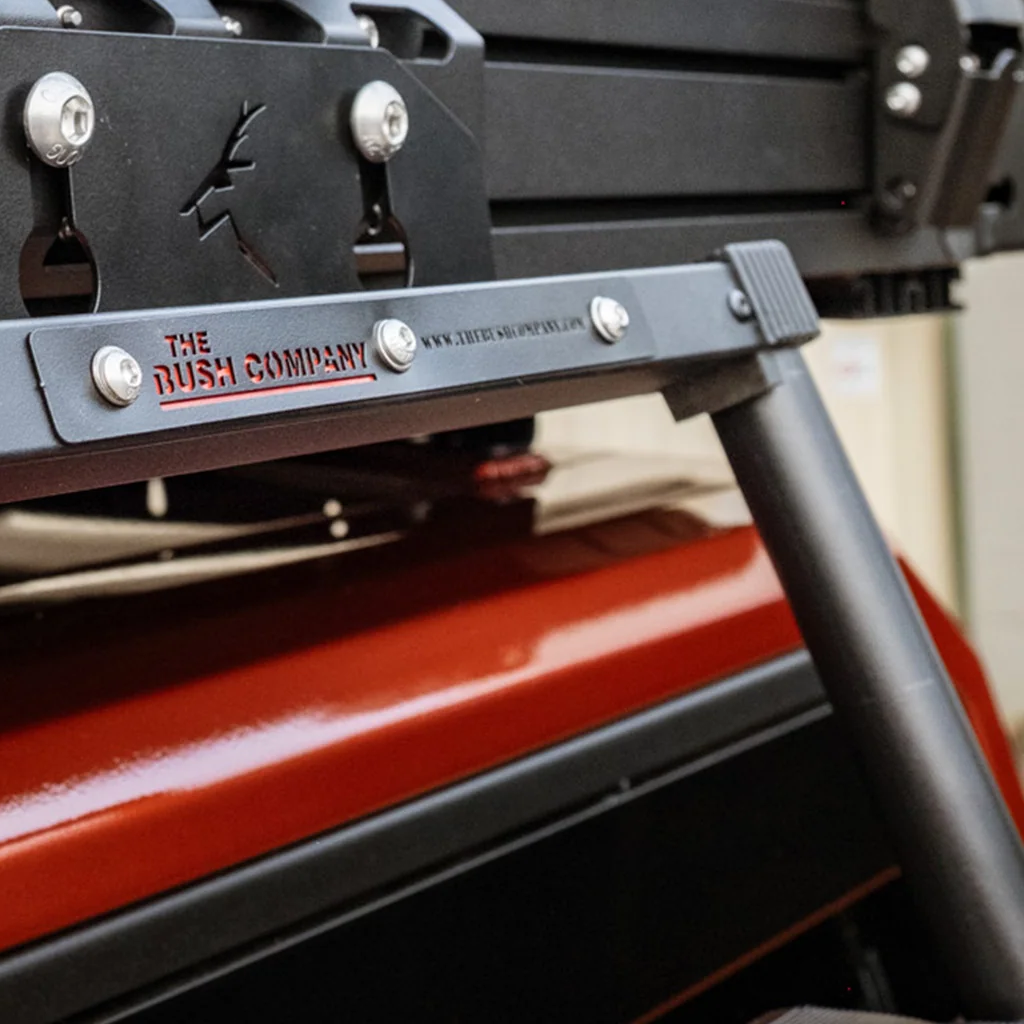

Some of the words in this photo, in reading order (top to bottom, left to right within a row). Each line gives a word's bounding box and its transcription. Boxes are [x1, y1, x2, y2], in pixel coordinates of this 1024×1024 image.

[164, 331, 212, 358] THE
[153, 356, 237, 395] BUSH
[244, 342, 368, 383] COMPANY
